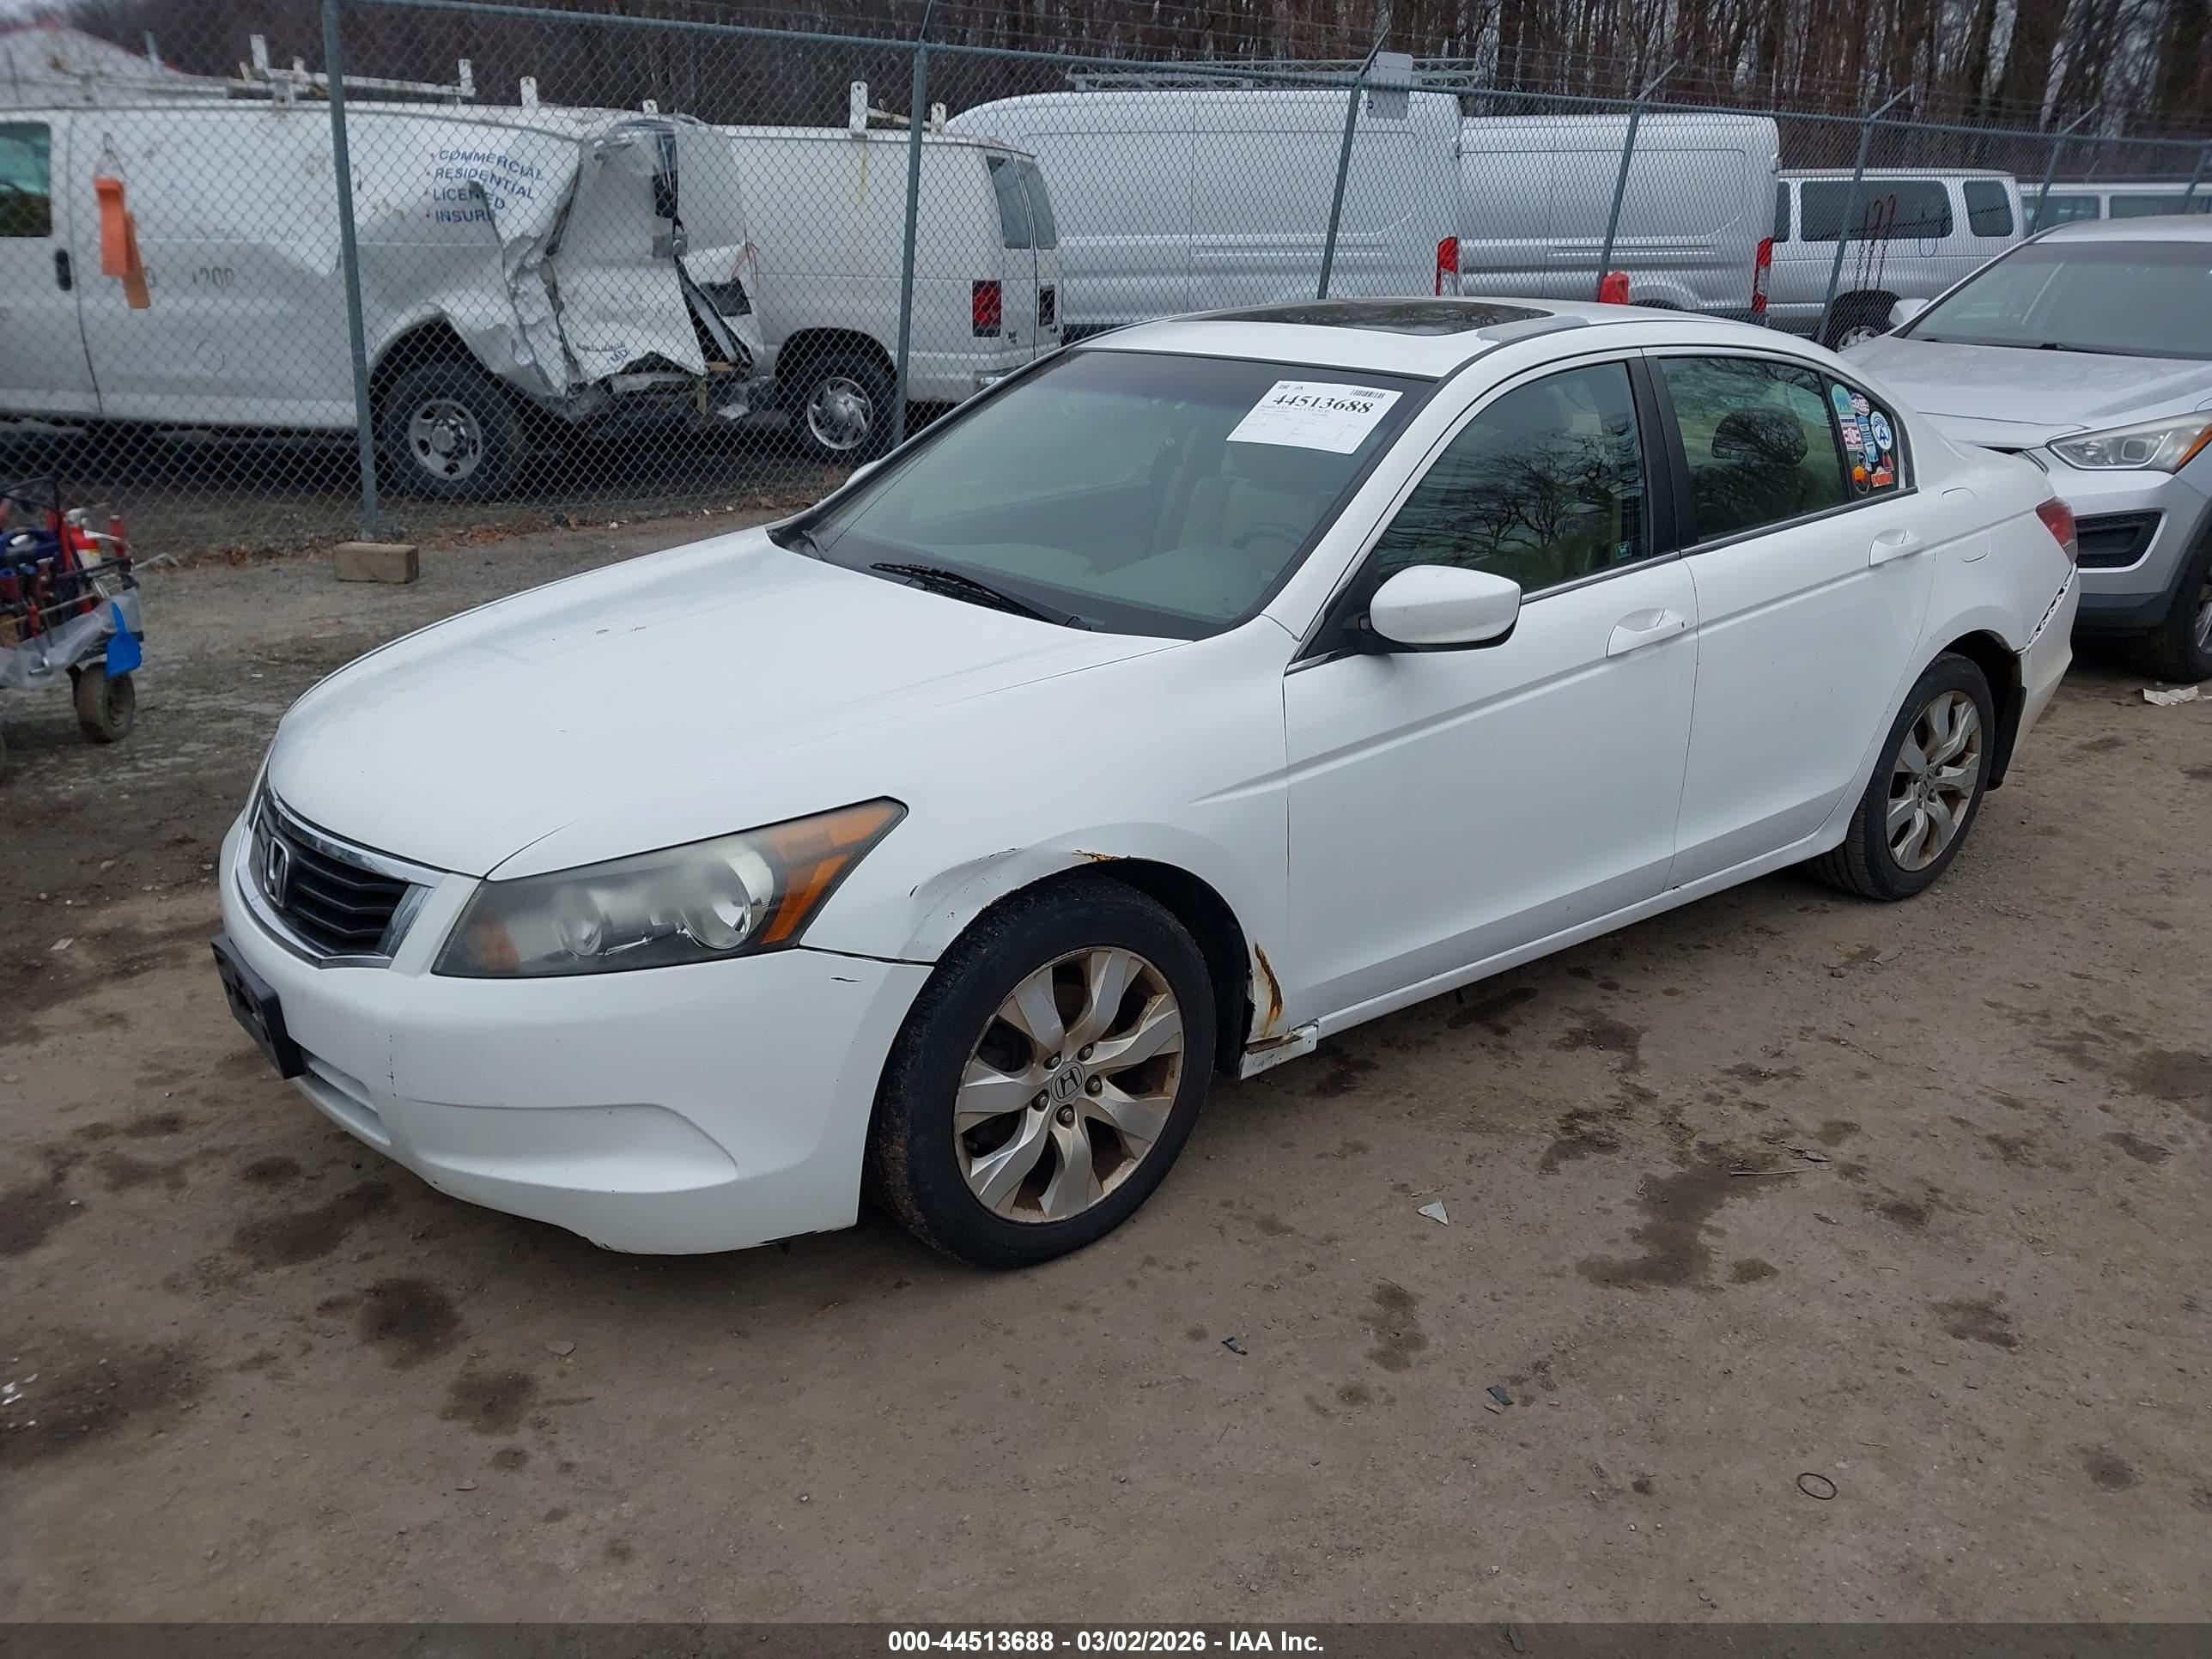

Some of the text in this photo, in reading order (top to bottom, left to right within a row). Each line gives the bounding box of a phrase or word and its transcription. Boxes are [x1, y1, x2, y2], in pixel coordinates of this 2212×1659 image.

[439, 150, 543, 180] COMMERCIAL
[435, 167, 534, 199] RESIDENTIAL
[433, 188, 506, 210] LICENED
[1273, 394, 1374, 413] 44513688
